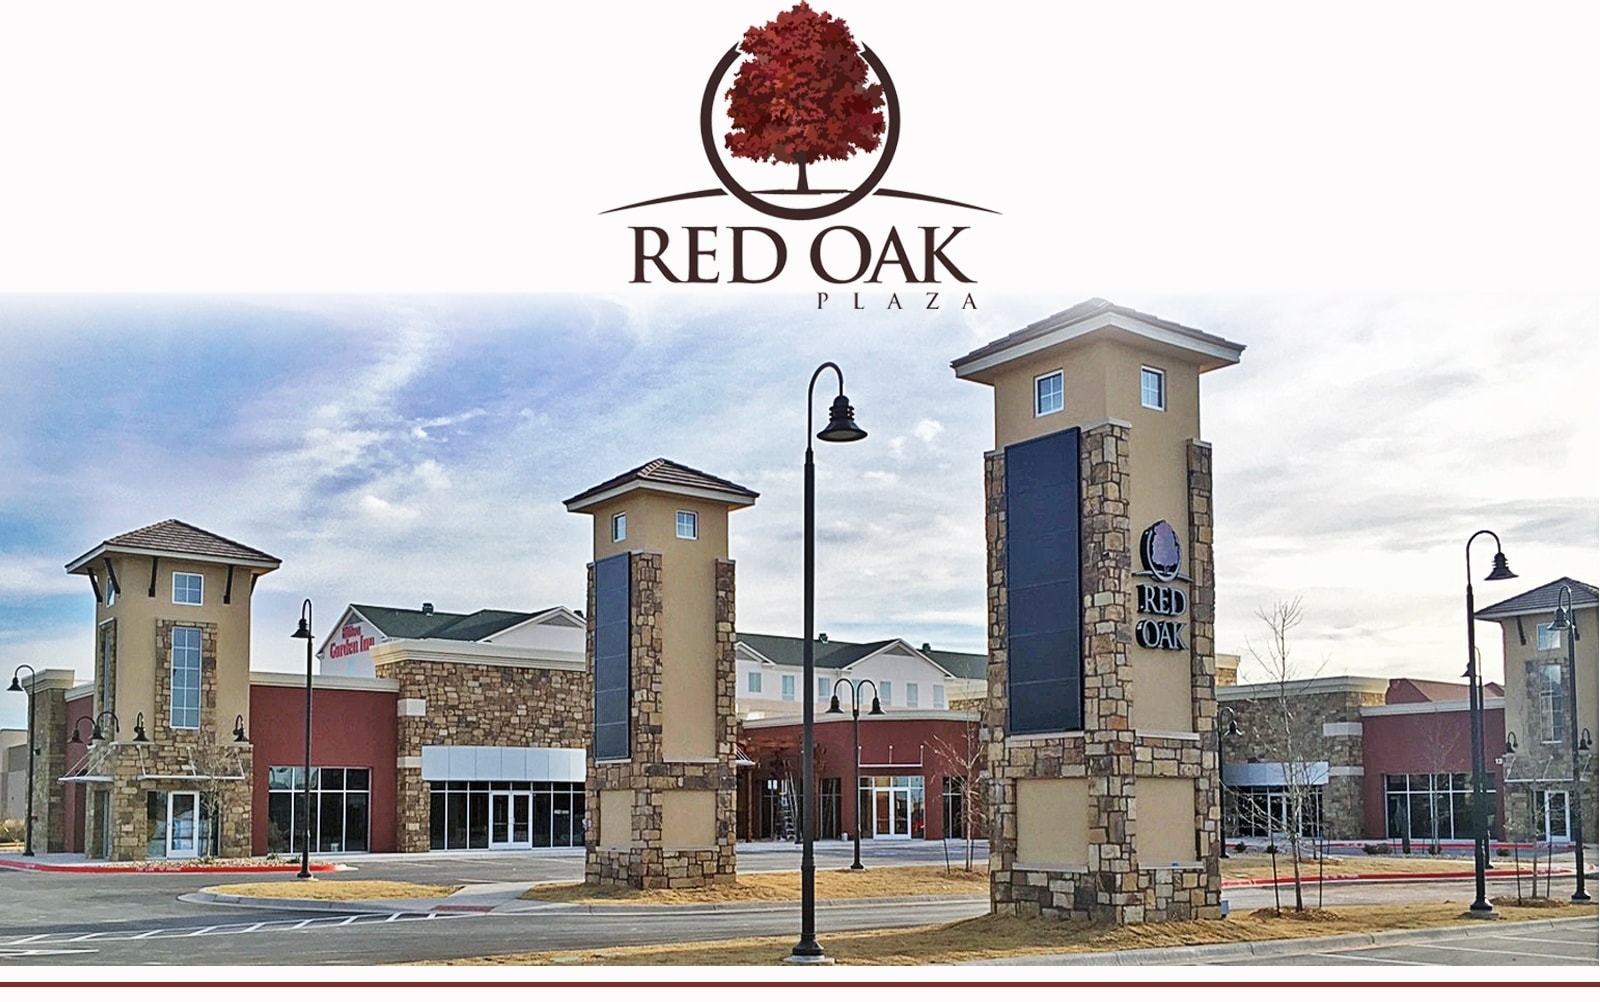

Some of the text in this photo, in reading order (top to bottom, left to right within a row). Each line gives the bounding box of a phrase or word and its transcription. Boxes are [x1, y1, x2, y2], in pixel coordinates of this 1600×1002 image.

[1138, 584, 1187, 615] RED
[1137, 618, 1187, 649] OAK
[330, 640, 358, 659] Garden
